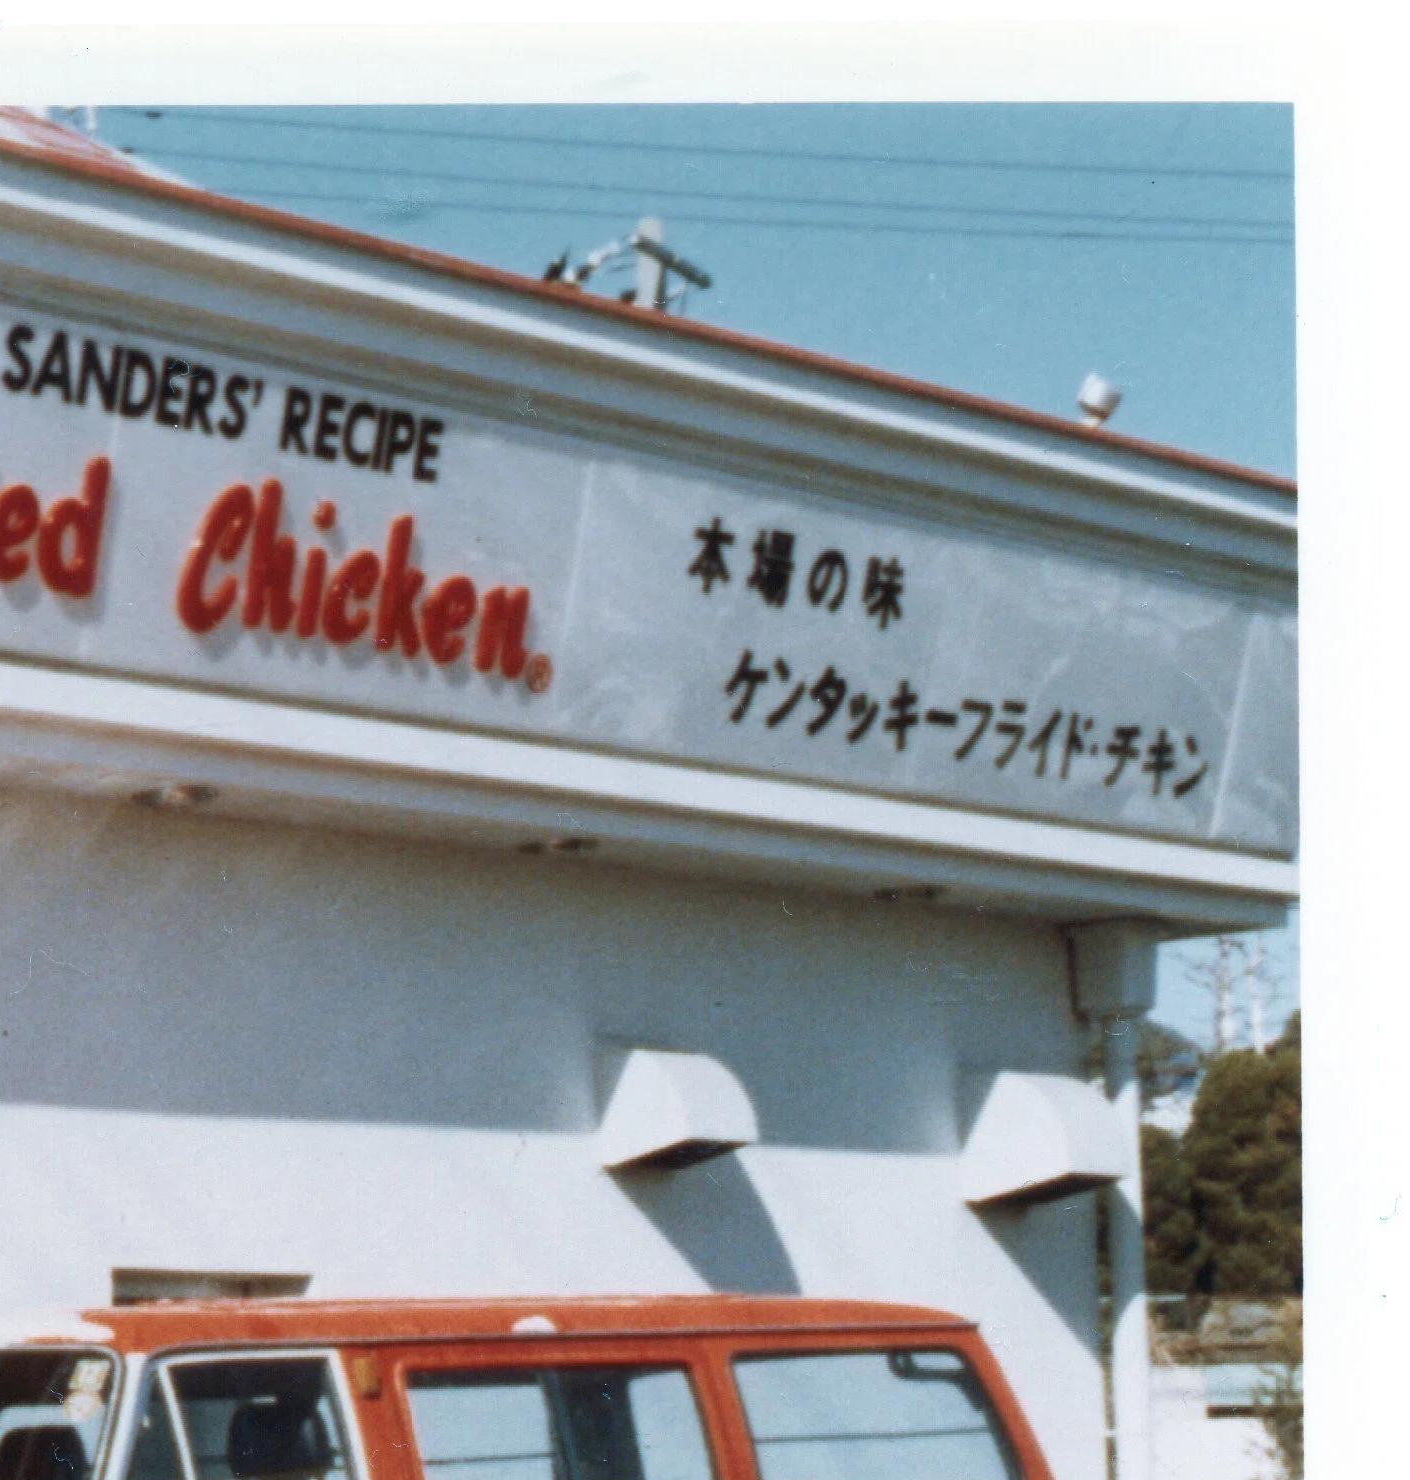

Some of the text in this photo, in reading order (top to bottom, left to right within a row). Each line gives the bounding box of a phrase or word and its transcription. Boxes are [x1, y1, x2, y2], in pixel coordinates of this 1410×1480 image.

[0, 324, 264, 440] SANDERS'
[279, 386, 446, 483] RECIPE
[175, 479, 531, 680] Chicken
[688, 516, 906, 632] 本場の味
